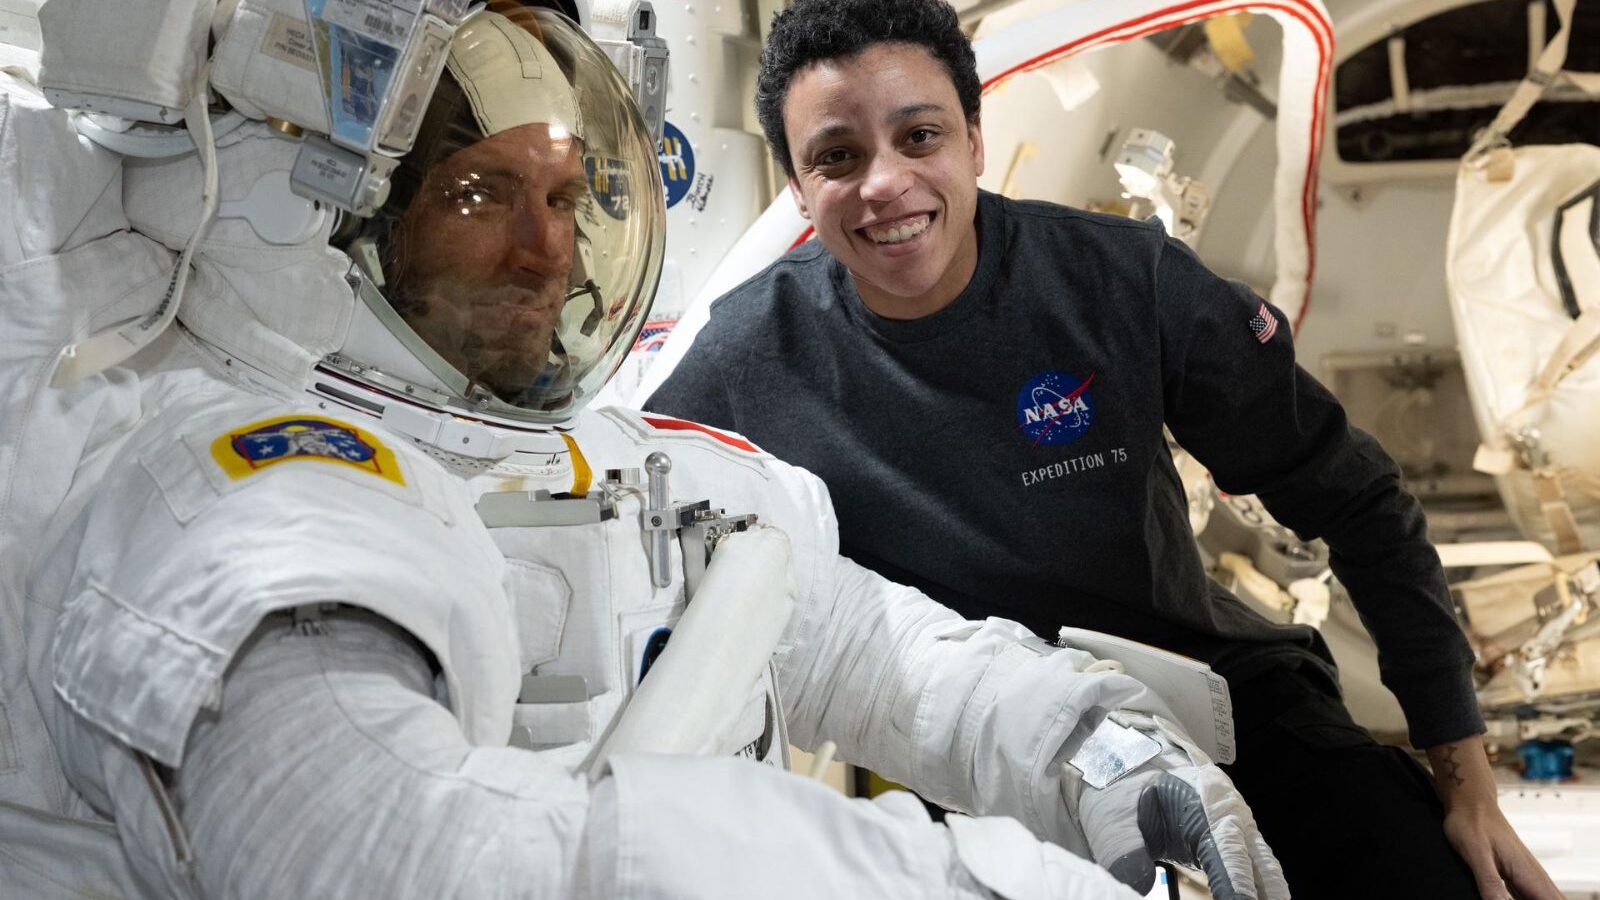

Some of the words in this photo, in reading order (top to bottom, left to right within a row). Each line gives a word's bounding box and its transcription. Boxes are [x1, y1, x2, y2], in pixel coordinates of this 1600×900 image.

[1023, 396, 1089, 424] NASA
[1022, 453, 1104, 486] EXPEDITION
[1110, 448, 1127, 464] 75
